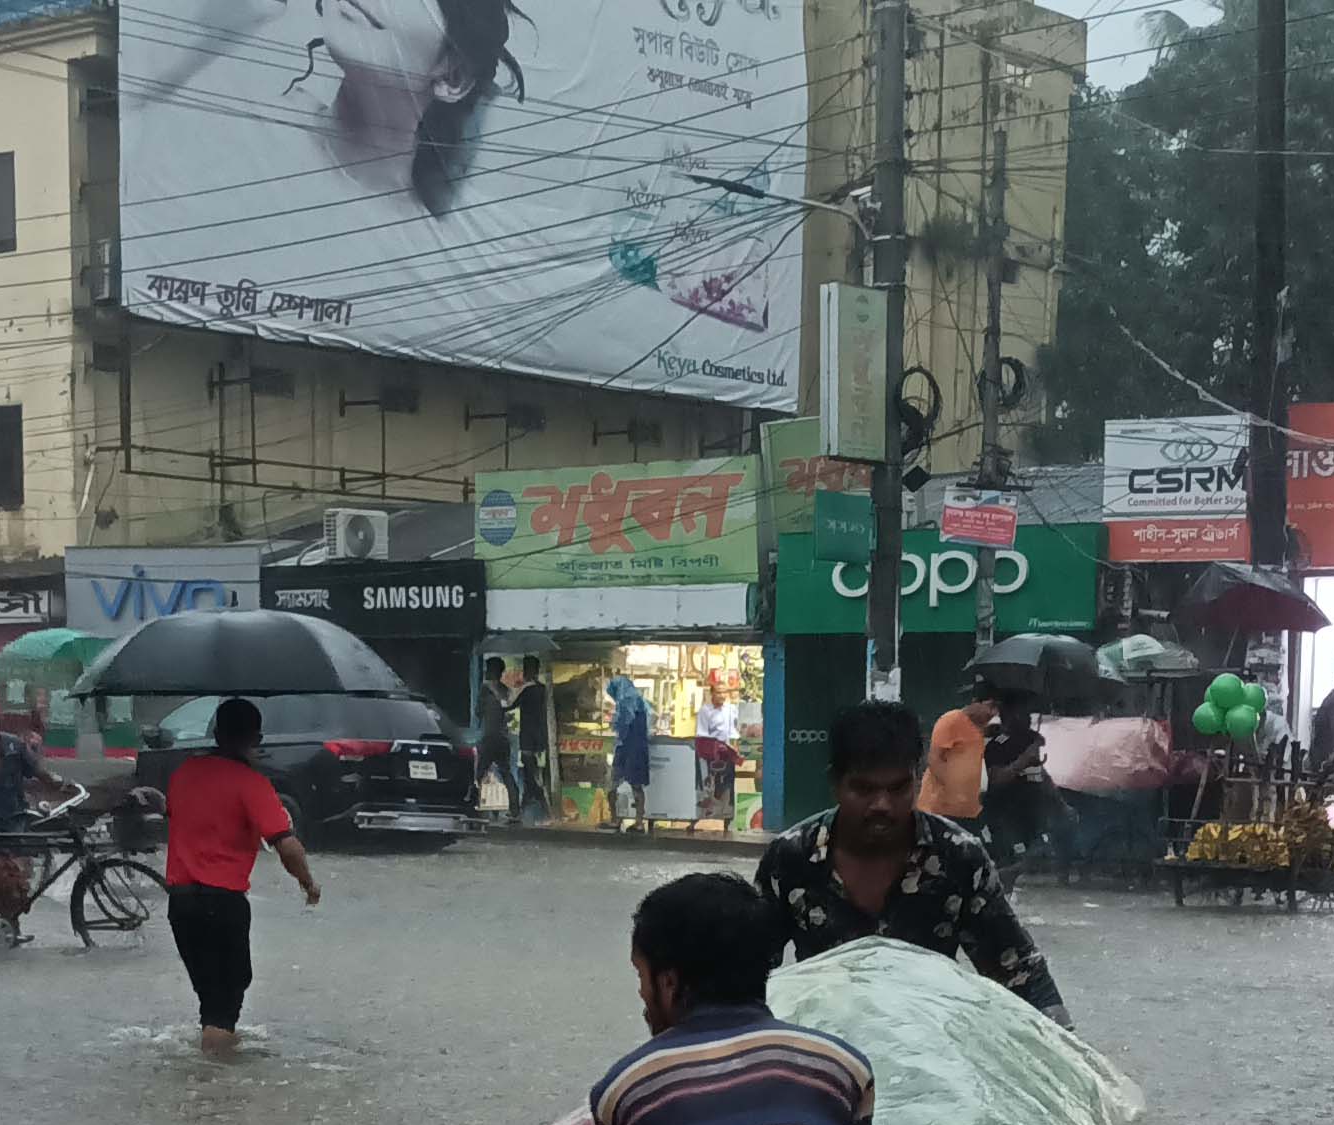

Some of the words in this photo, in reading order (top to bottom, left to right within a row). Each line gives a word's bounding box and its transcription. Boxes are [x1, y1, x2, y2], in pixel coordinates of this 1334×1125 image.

[214, 278, 264, 318] তুমি
[701, 358, 765, 385] Cosmetics
[521, 471, 746, 555] মধুবন
[1178, 495, 1193, 505] for
[362, 585, 465, 610] SAMSUNG
[788, 729, 828, 745] oppo
